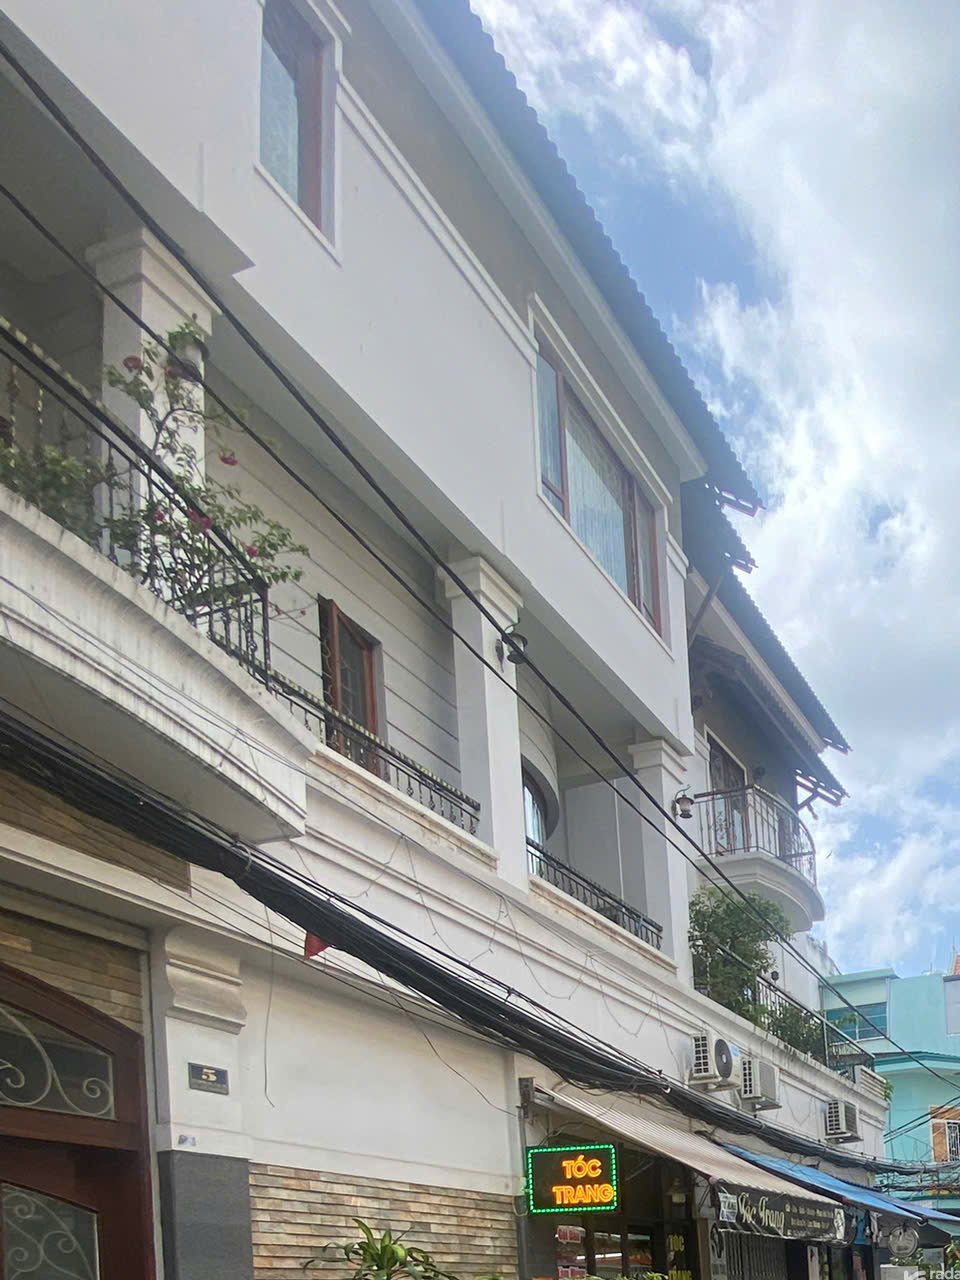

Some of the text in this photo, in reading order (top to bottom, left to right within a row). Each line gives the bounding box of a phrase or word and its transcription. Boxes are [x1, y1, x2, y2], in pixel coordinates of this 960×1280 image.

[202, 1068, 217, 1081] 5
[562, 1155, 602, 1178] TÓC
[552, 1184, 614, 1204] TRANG
